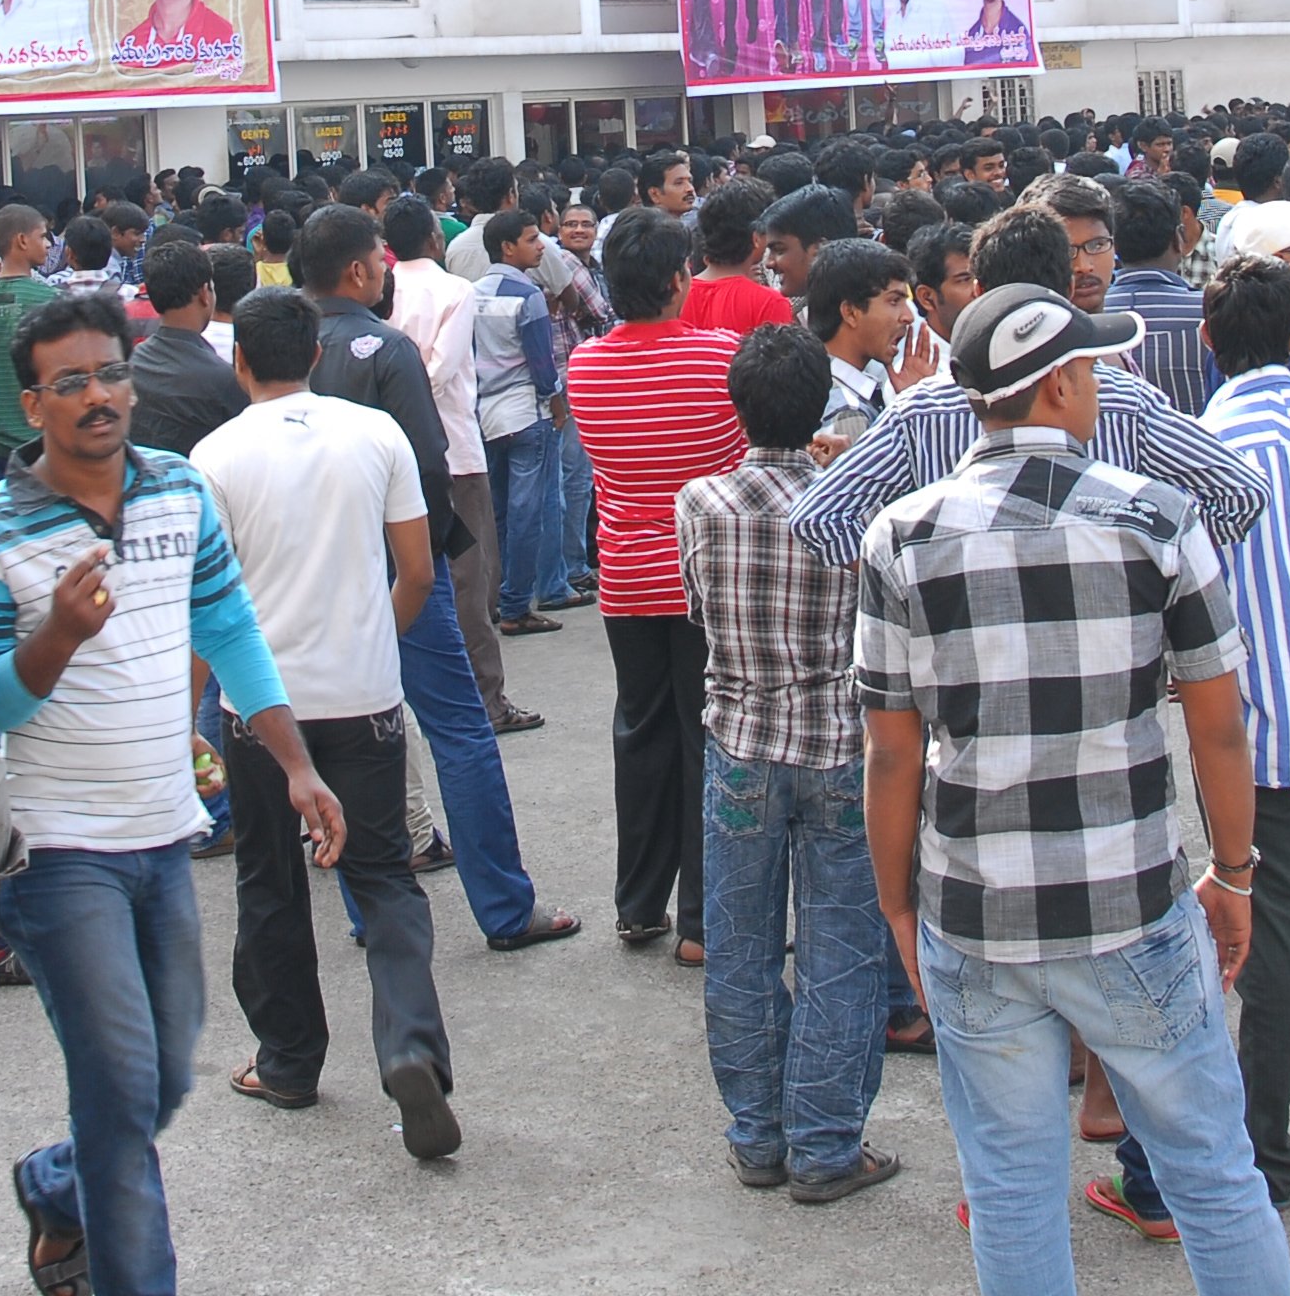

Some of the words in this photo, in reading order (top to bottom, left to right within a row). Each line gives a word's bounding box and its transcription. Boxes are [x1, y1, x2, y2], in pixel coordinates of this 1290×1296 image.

[199, 36, 241, 58] కుమార్
[381, 113, 407, 122] LADIES
[448, 111, 473, 120] GENTS
[241, 129, 270, 140] GENTS
[315, 126, 343, 137] LADIES
